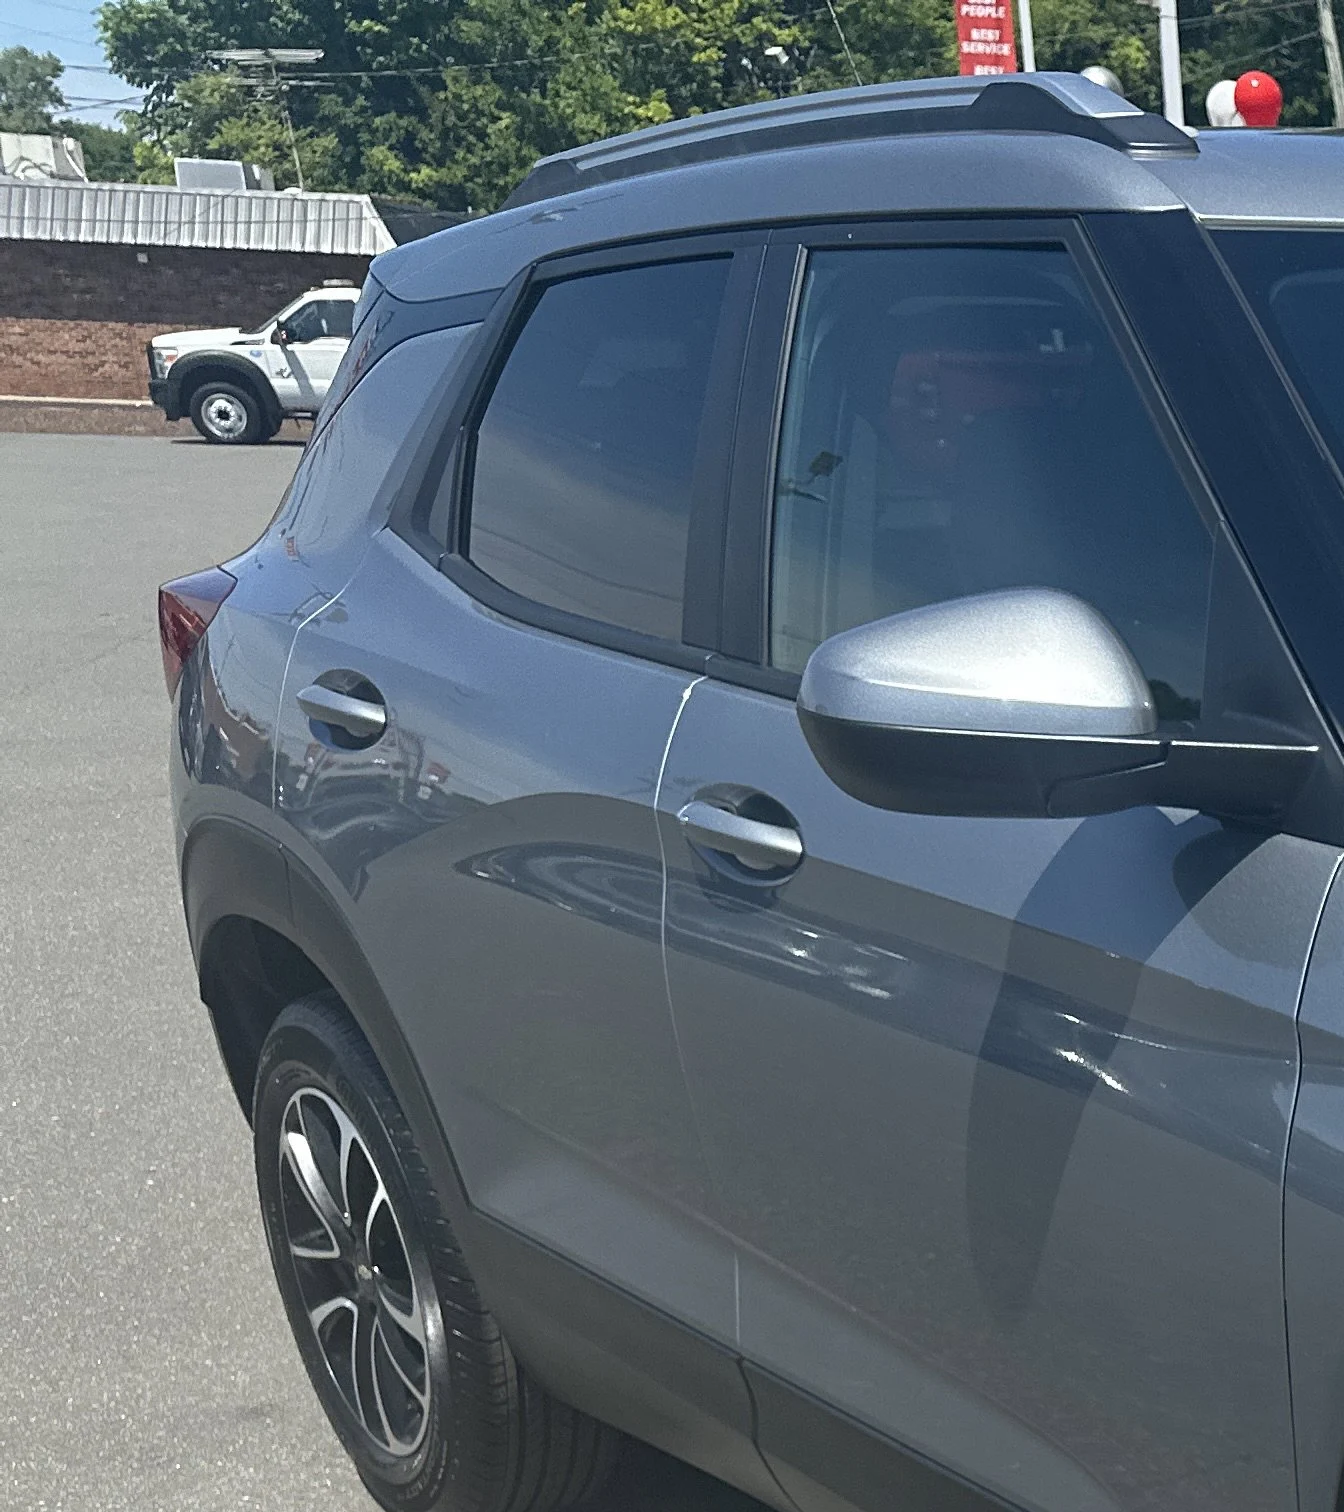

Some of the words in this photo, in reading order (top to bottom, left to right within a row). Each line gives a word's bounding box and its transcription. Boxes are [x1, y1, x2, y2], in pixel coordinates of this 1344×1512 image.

[960, 4, 1006, 19] PEOPLE
[970, 27, 1001, 42] BEST
[960, 41, 1012, 56] SERVICE
